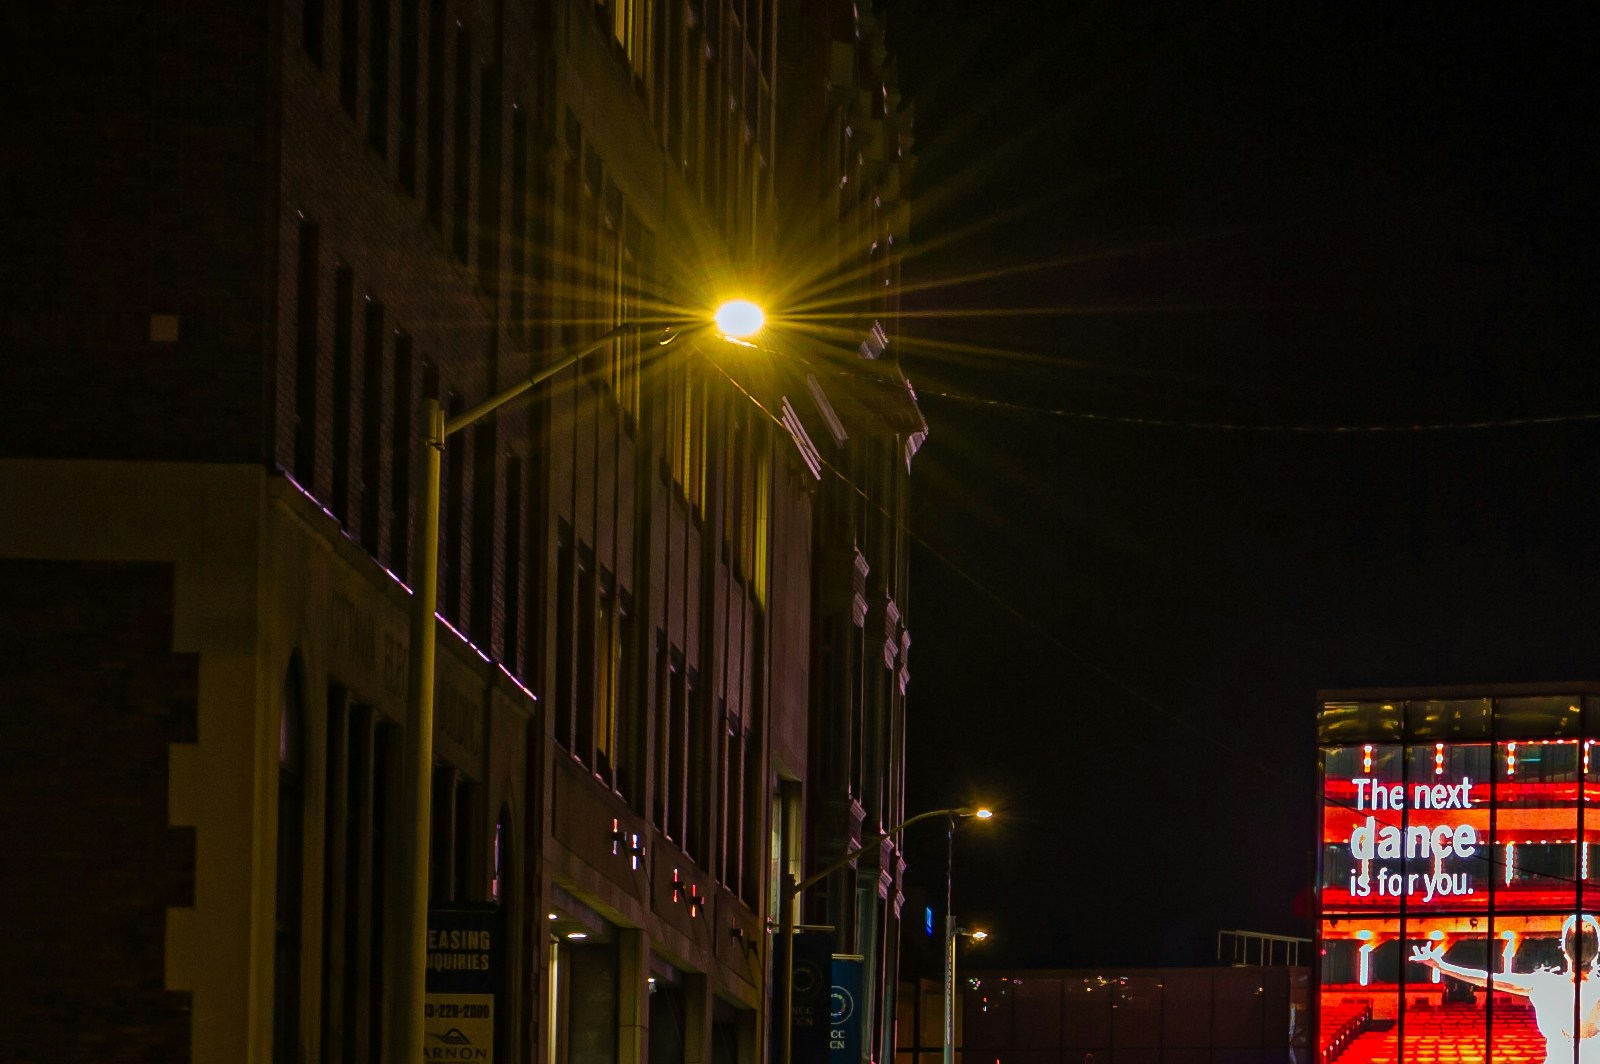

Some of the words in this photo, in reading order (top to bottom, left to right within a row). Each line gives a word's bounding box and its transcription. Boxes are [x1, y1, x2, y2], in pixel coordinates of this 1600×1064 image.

[1352, 778, 1404, 810] The
[1415, 777, 1472, 809] next
[1351, 816, 1476, 859] dance
[1350, 868, 1371, 896] is
[1377, 867, 1419, 896] for
[1423, 872, 1474, 902] you.
[428, 929, 490, 950] EASING
[428, 953, 490, 972] NQUIRIES
